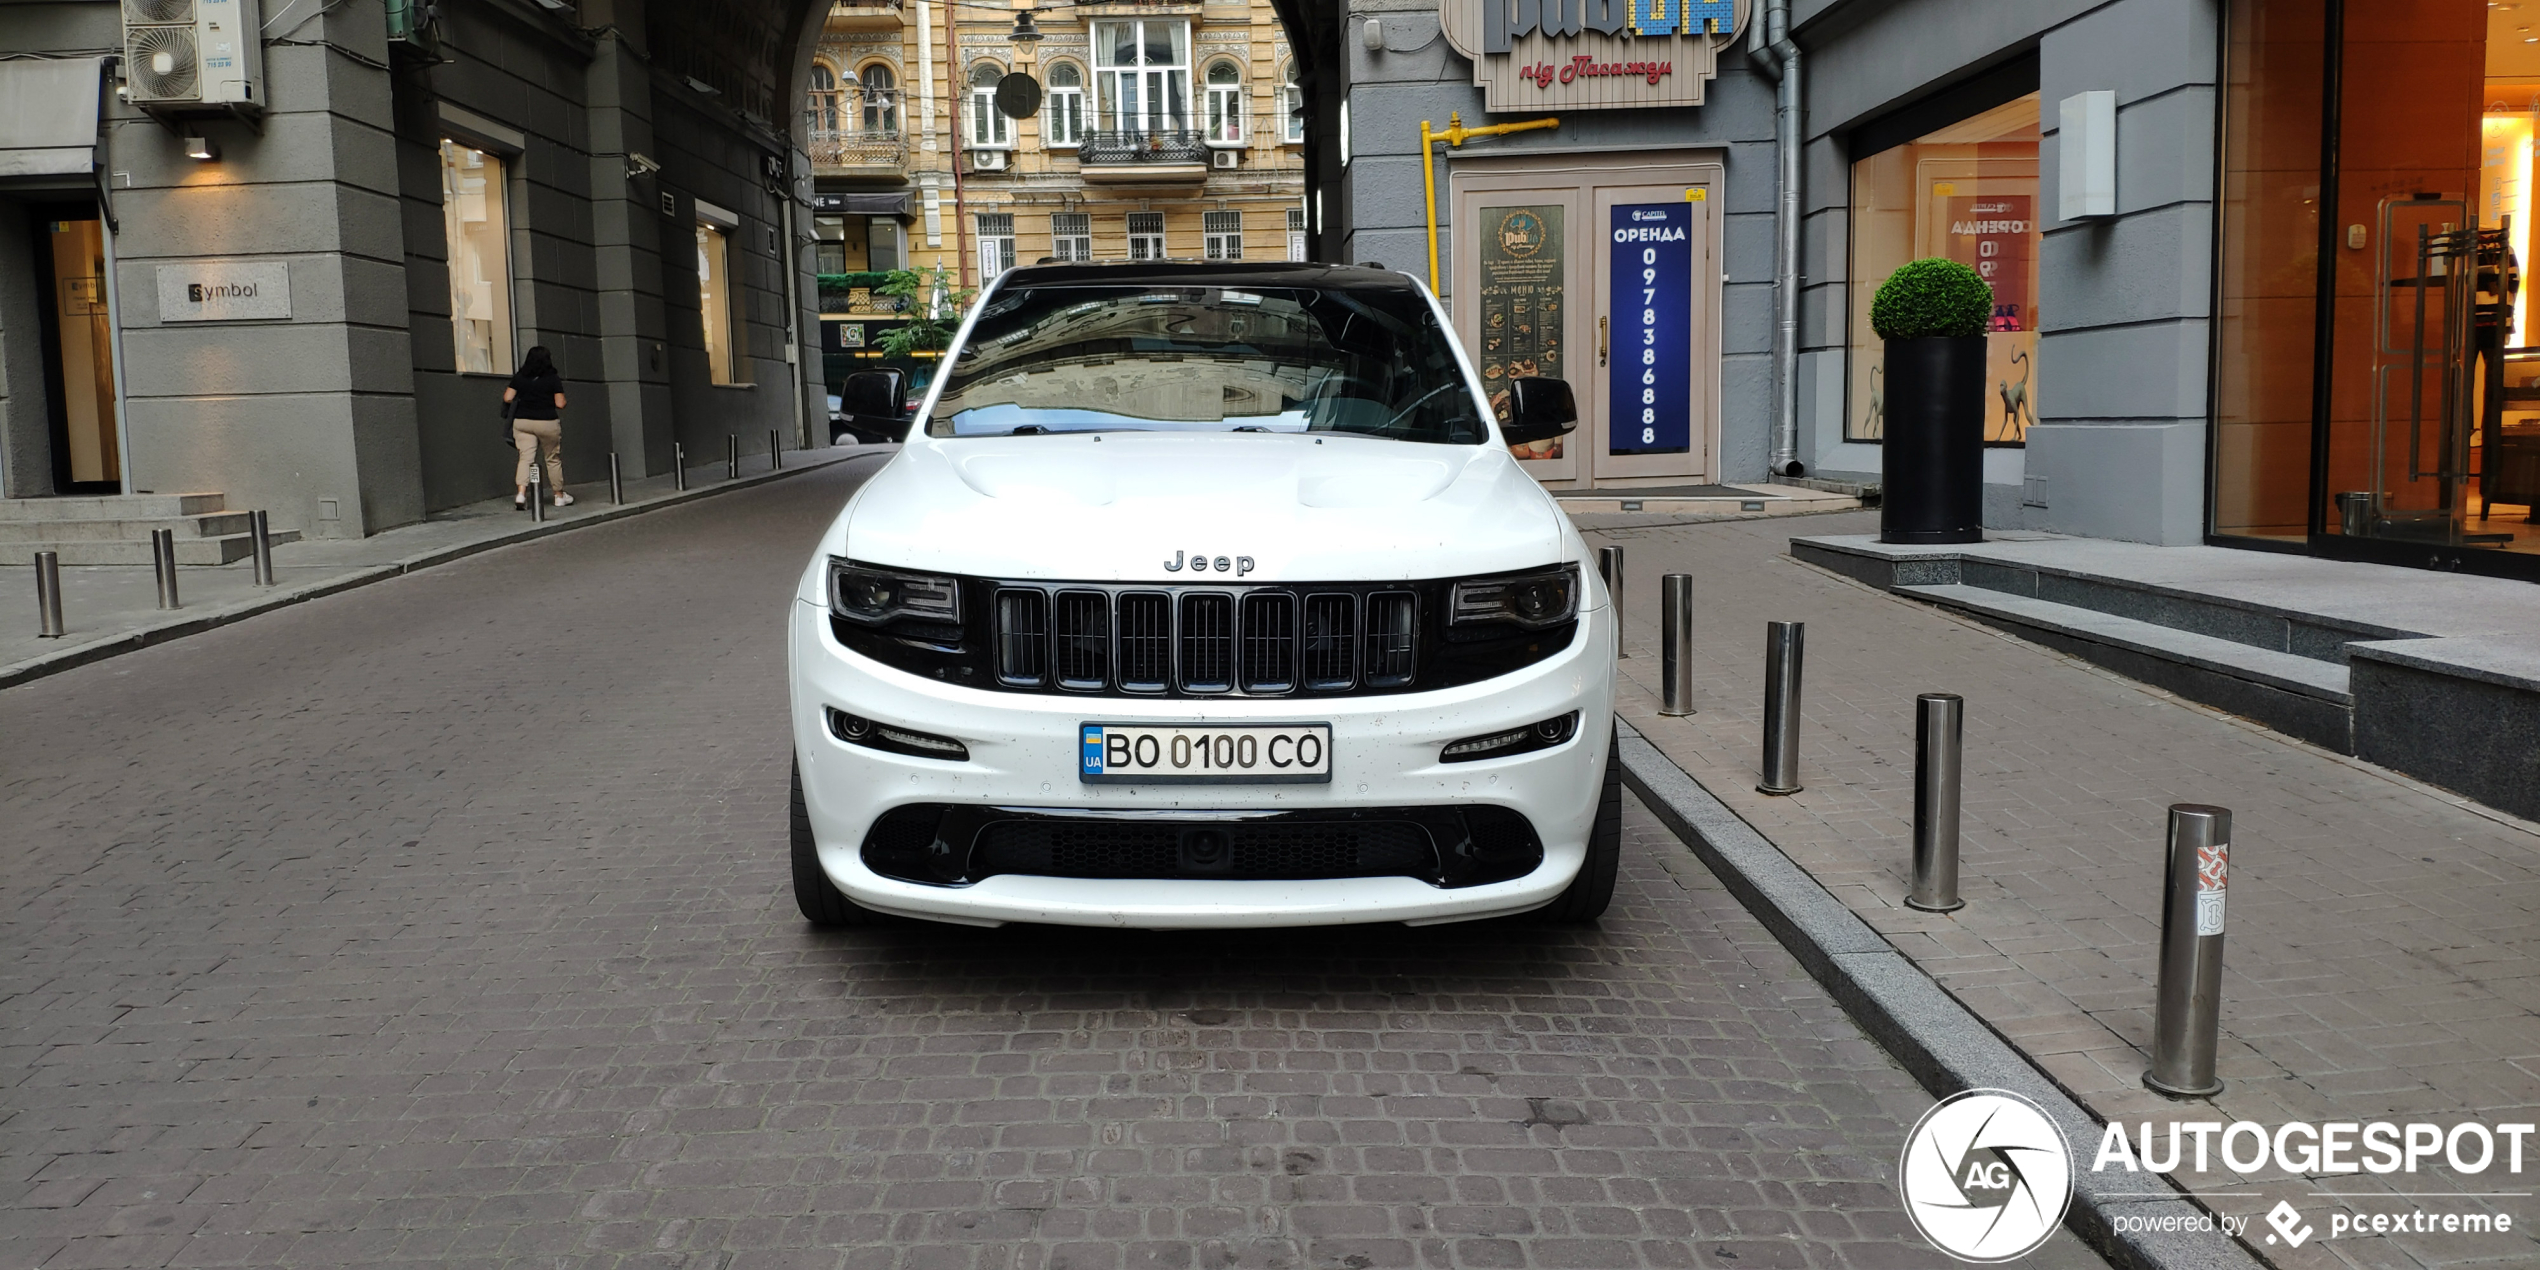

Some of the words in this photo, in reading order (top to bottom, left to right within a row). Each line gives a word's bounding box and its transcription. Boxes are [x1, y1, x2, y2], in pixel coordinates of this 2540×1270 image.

[1559, 55, 1673, 85] Пасажем
[1613, 226, 1686, 243] ОРЕНДА
[1163, 550, 1255, 577] Jeep
[1085, 756, 1102, 768] UA
[1106, 733, 1160, 769] BO
[1170, 734, 1258, 769] 0100
[1268, 734, 1322, 768] CO
